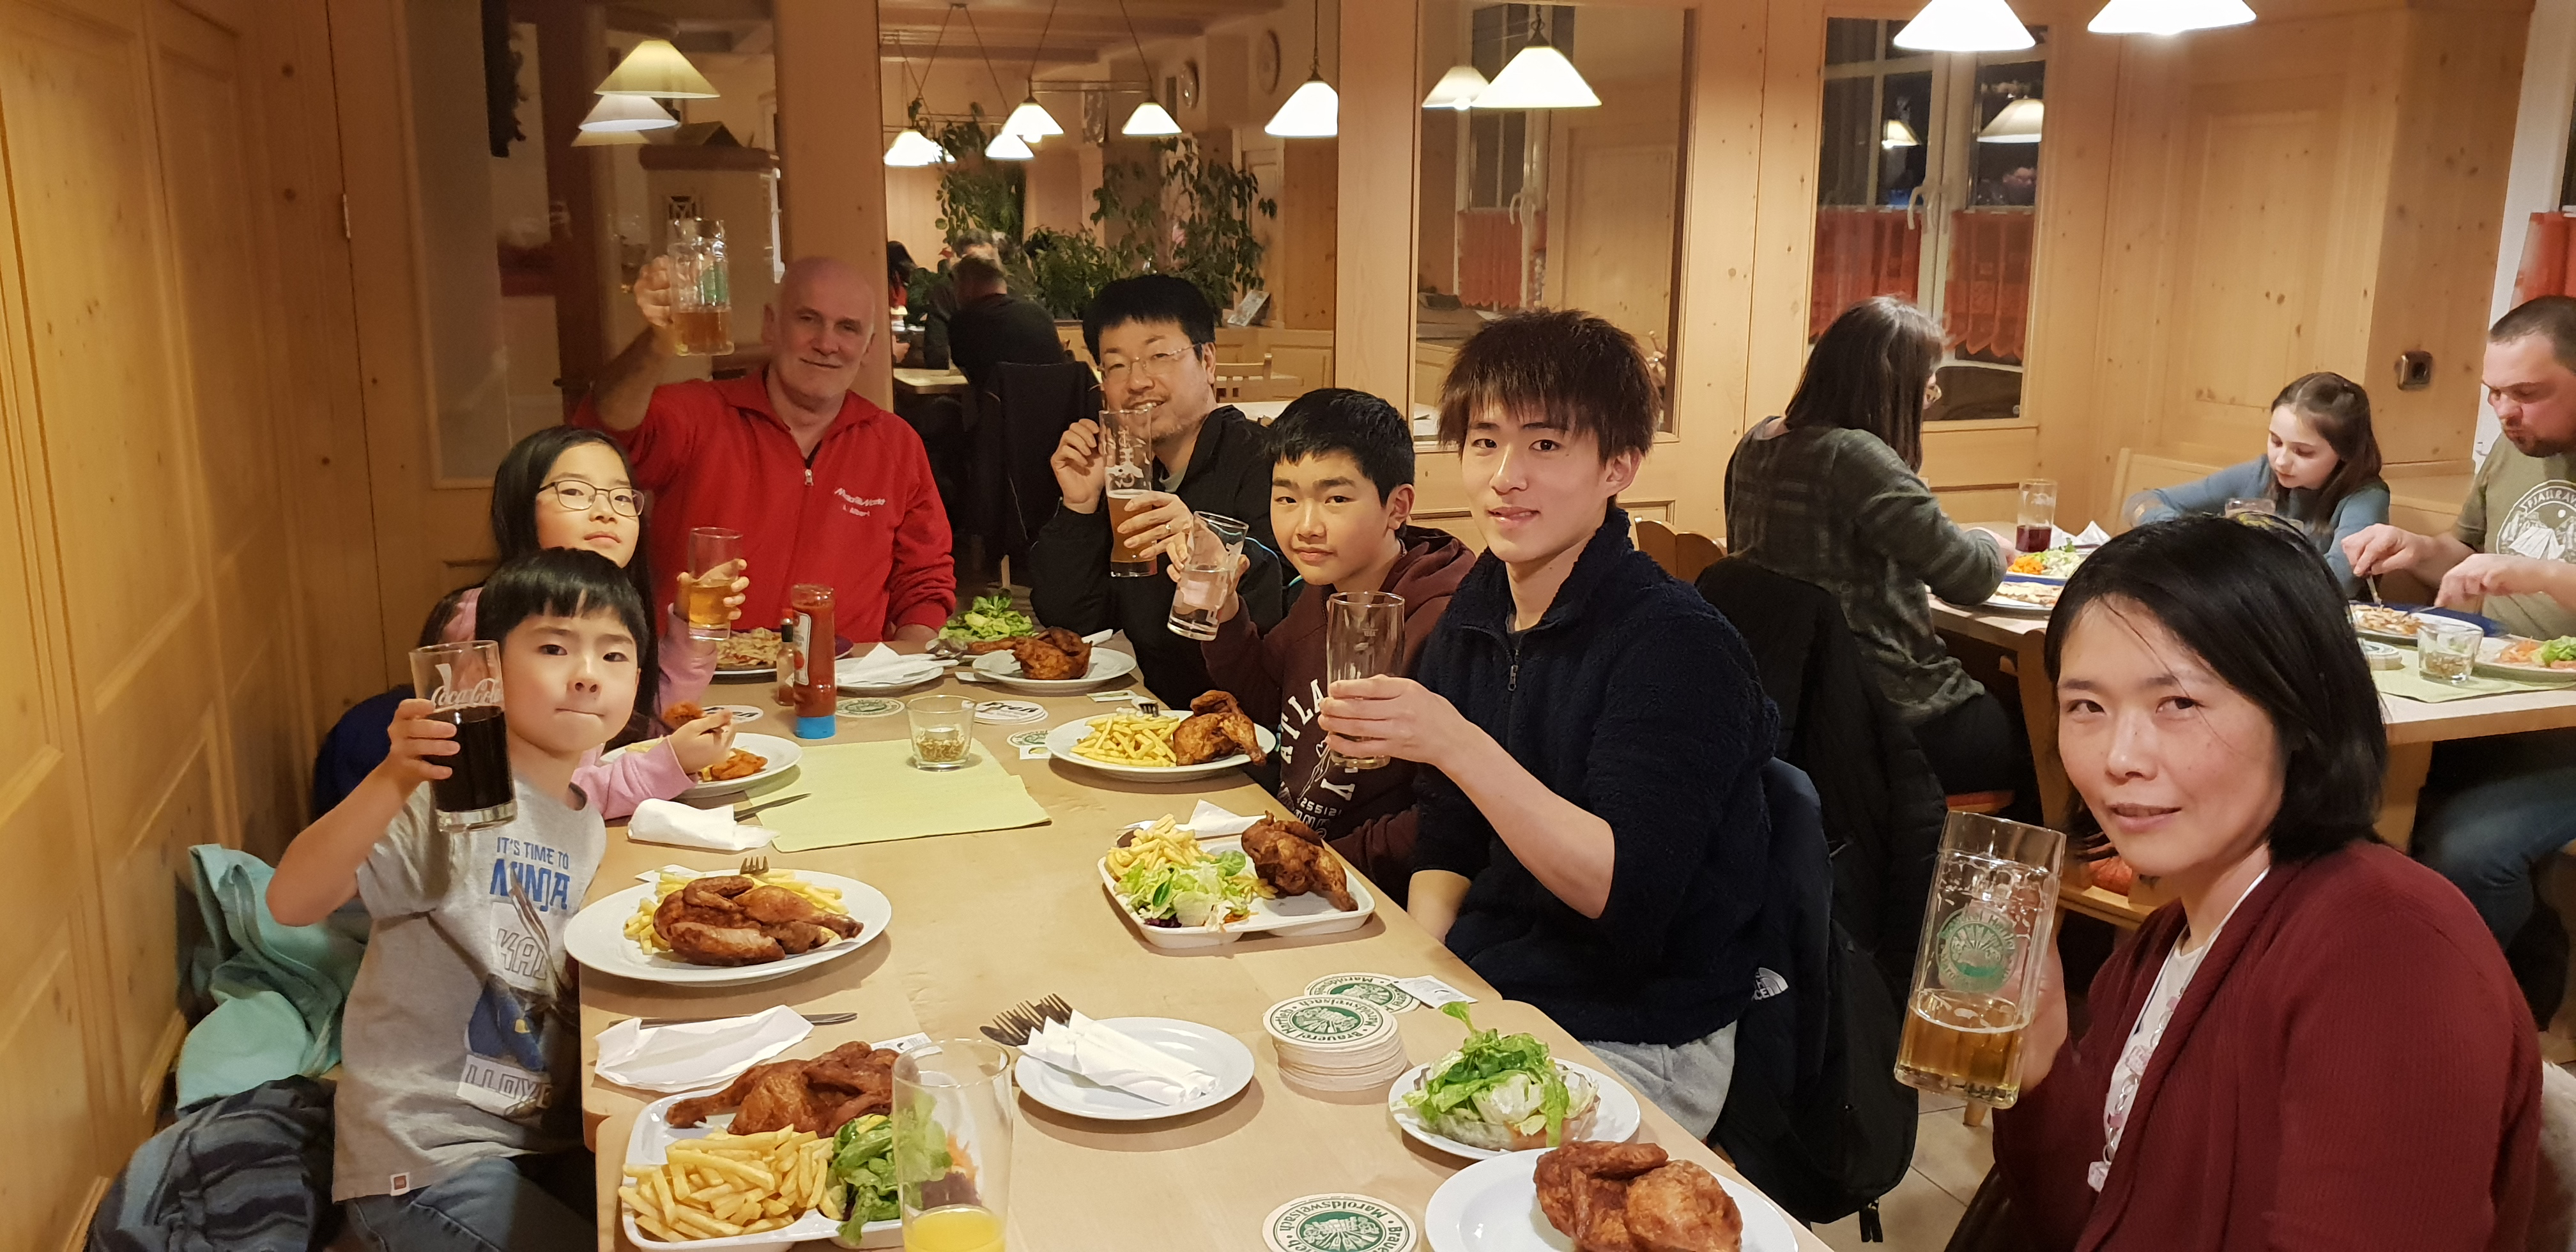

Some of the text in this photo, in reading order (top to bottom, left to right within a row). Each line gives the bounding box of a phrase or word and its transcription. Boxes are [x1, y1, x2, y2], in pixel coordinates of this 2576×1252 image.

[496, 836, 569, 869] IT'S TIME TO
[489, 858, 570, 912] NINJA
[1296, 1031, 1363, 1041] Brauerei
[1279, 1201, 1388, 1232] Maroldsweisach
[1377, 1226, 1403, 1252] Braue
